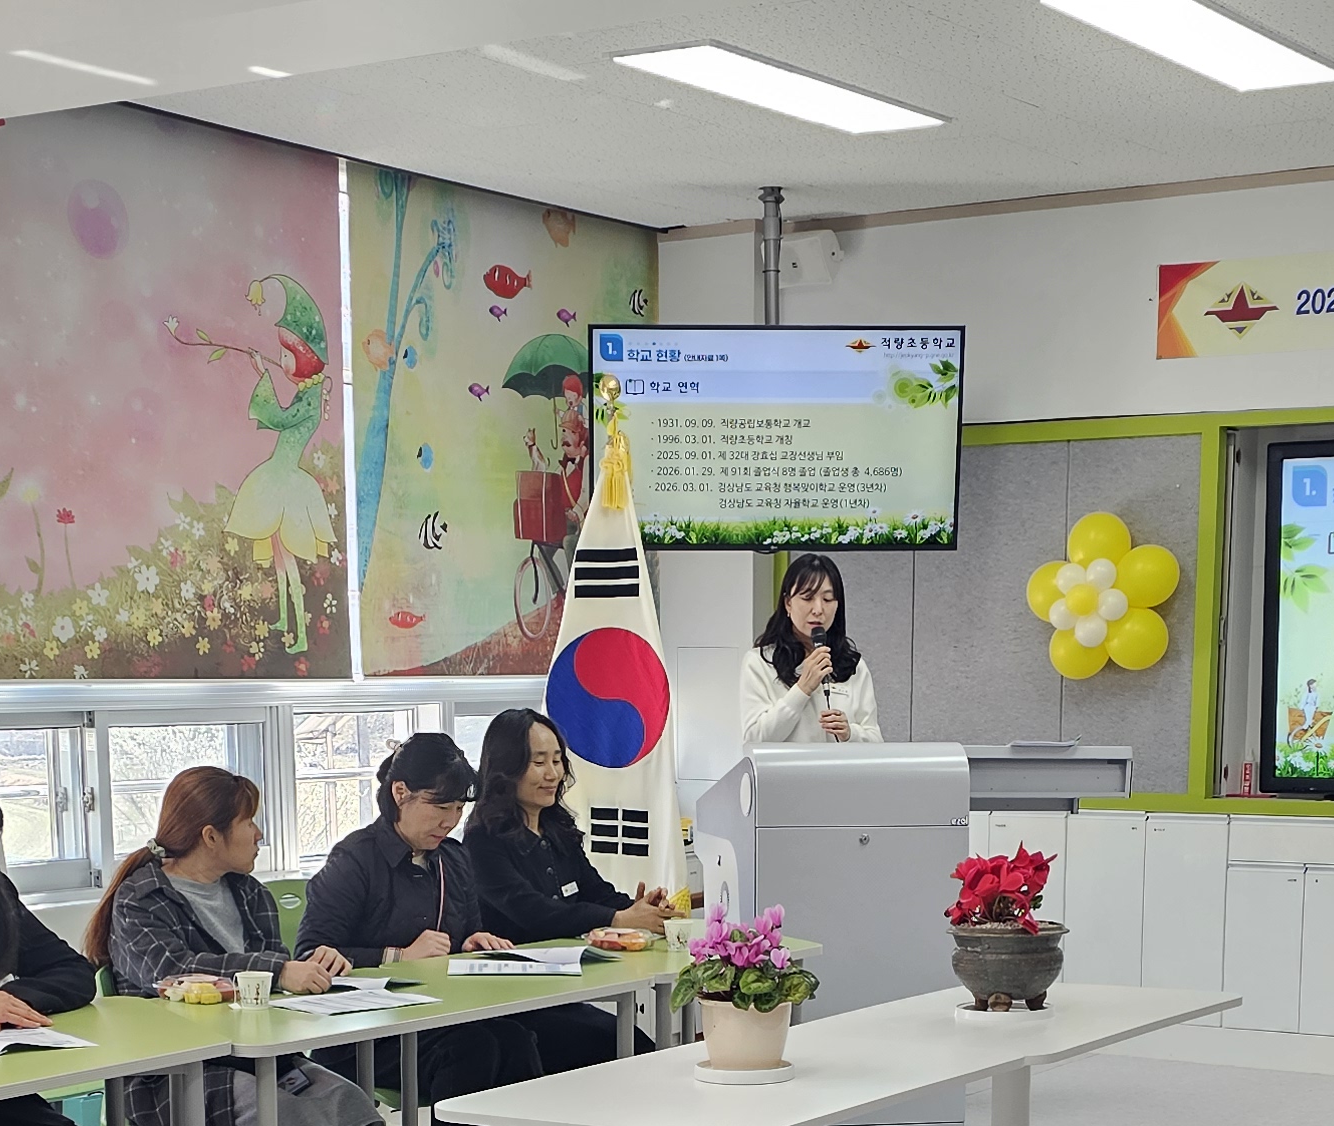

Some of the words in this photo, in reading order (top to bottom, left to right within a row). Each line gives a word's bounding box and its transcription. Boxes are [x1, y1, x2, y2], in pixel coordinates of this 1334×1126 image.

[881, 337, 955, 349] 적량초등학교
[628, 349, 652, 362] 학교
[656, 349, 681, 362] 현황
[650, 381, 672, 393] 학교
[678, 381, 699, 393] 연혁
[658, 418, 682, 428] 1931.
[685, 418, 699, 428] 09.
[702, 418, 715, 428] 09.
[658, 435, 682, 444] 1996.
[685, 435, 699, 444] 03.
[702, 435, 715, 444] 01.
[657, 451, 682, 460] 2025.
[685, 451, 699, 460] 09.
[702, 451, 715, 460] 01.
[657, 467, 682, 476] 2026.
[685, 467, 699, 476] 01.
[702, 467, 715, 476] 29.
[655, 483, 680, 492] 2026.
[683, 483, 696, 492] 03.
[699, 483, 713, 492] 01.
[1303, 478, 1316, 496] 1.
